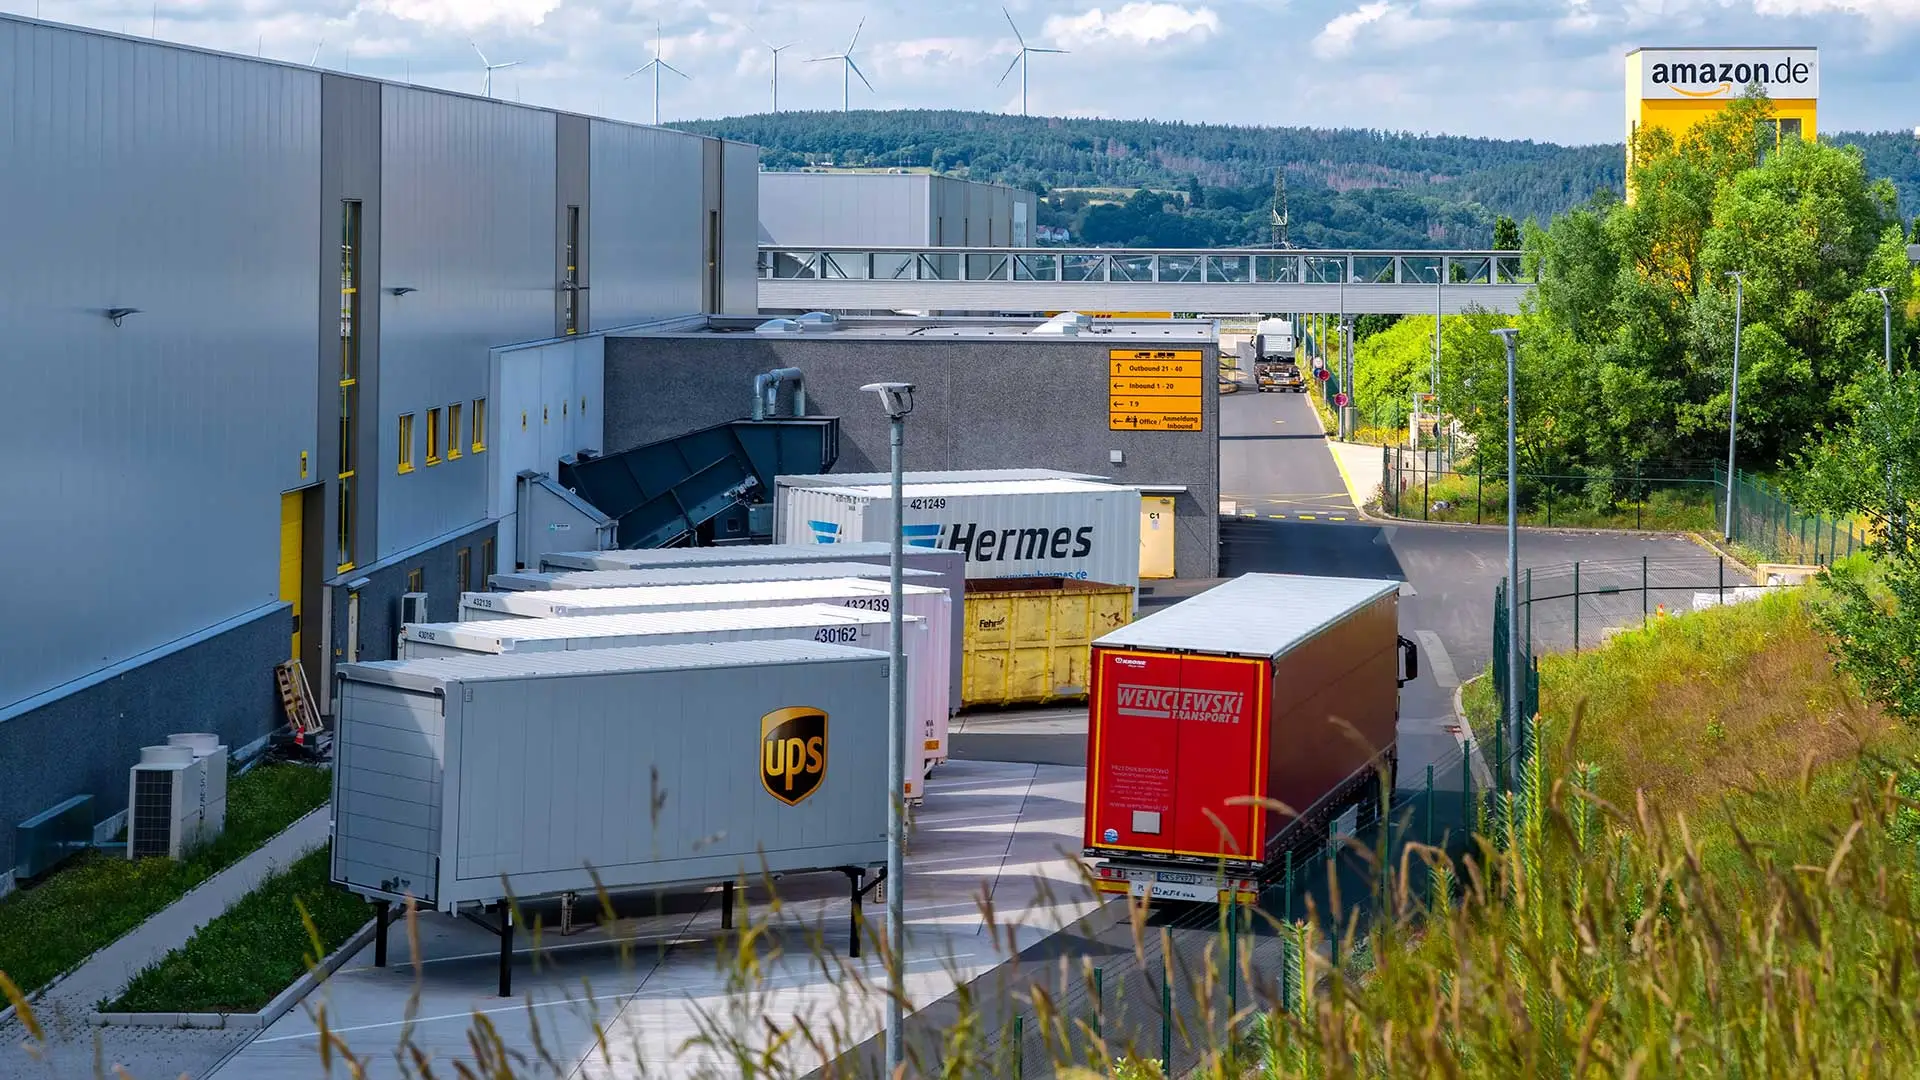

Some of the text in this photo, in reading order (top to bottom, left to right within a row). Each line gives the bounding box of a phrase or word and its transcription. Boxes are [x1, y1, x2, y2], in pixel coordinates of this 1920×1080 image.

[1652, 56, 1809, 84] amazon.de
[1129, 364, 1160, 372] Outbound
[1129, 382, 1155, 390] Inbound
[1162, 415, 1198, 423] Anmeldung
[910, 498, 946, 510] 421249
[950, 523, 1094, 562] Hermes
[473, 598, 492, 607] 432139
[814, 626, 857, 643] 430162
[1171, 709, 1232, 724] TRANSPORT
[765, 736, 824, 791] ups
